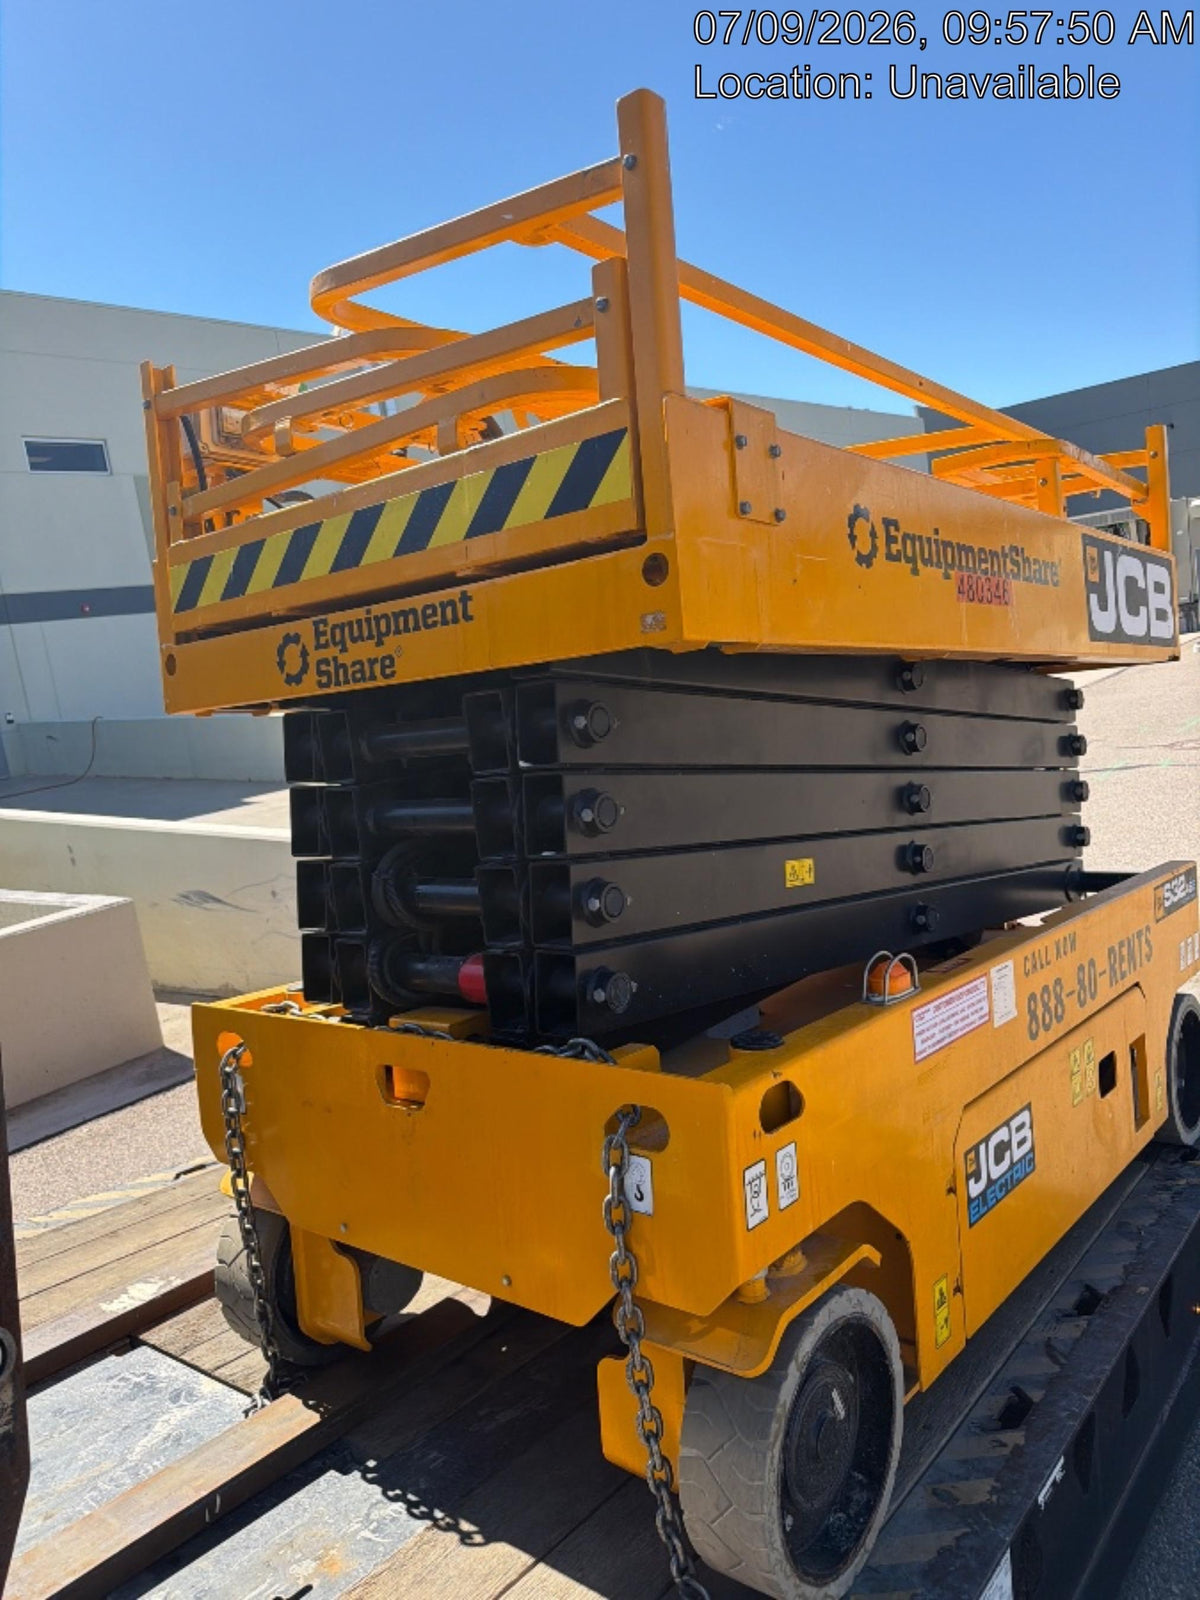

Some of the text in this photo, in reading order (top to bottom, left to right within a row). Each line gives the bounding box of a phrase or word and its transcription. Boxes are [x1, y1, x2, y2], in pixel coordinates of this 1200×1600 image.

[312, 590, 474, 653] Equipment
[1090, 550, 1175, 640] JCB
[1024, 931, 1077, 978] CALL NOW
[1027, 924, 1153, 1041] 888-80-RENTS
[968, 1109, 1032, 1198] JCB
[970, 1152, 1034, 1223] ELECTRIC
